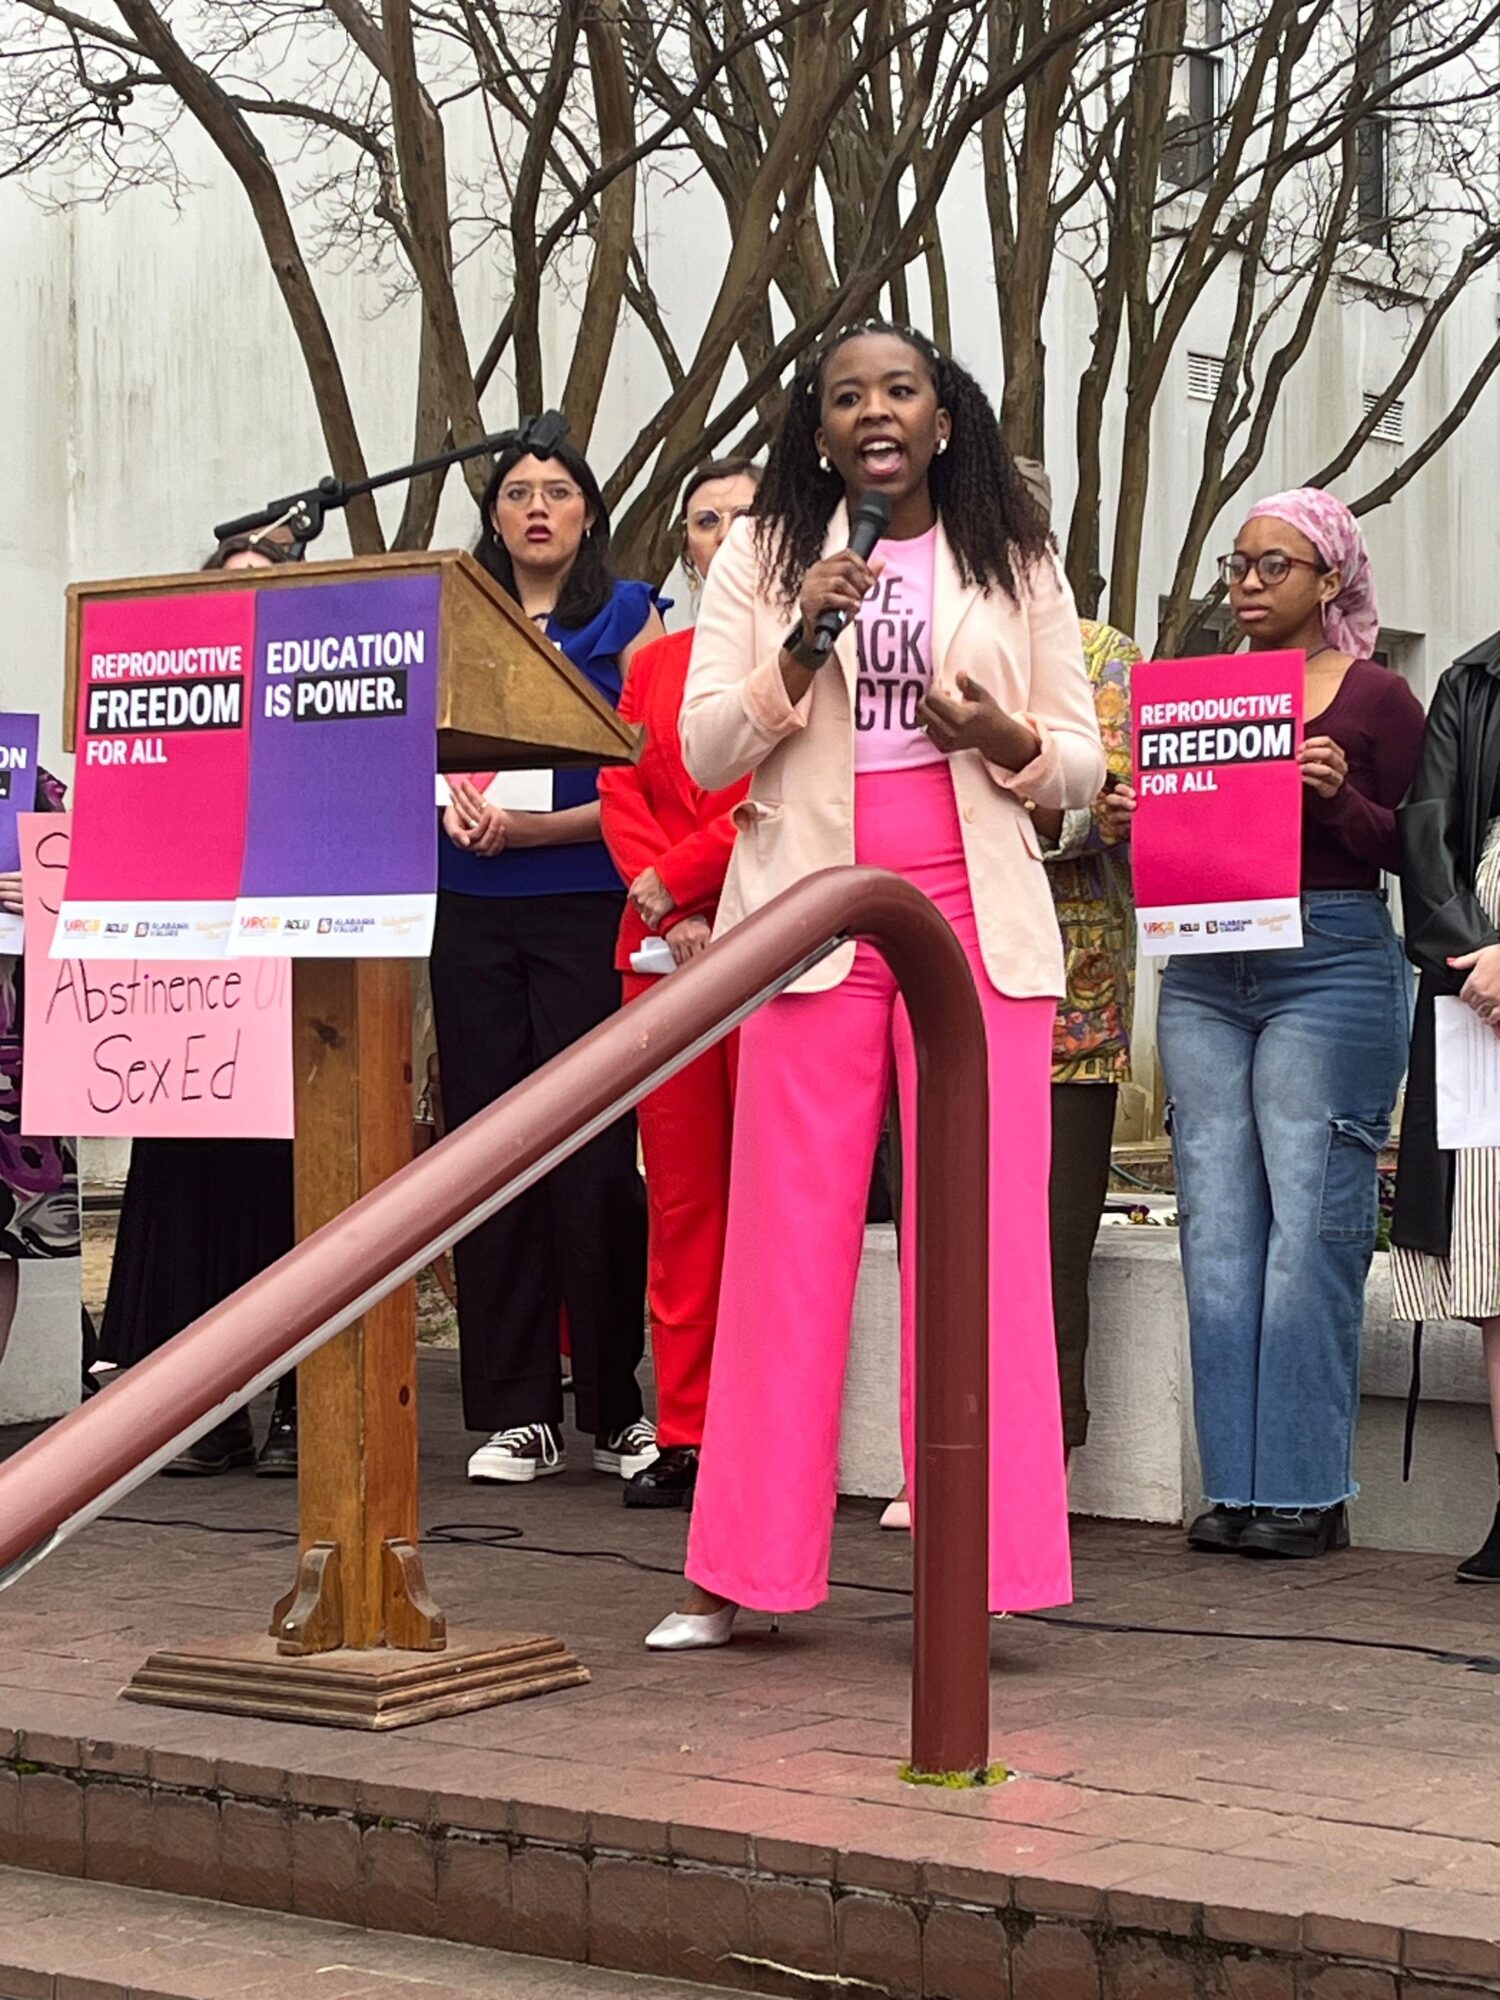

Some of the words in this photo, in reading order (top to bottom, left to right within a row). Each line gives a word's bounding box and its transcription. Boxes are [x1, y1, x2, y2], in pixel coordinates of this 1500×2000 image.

[91, 645, 242, 679] REPRODUCTIVE
[266, 630, 424, 674] EDUCATION
[89, 683, 240, 729] FREEDOM
[264, 683, 291, 717] IS
[297, 676, 403, 716] POWER.
[1141, 693, 1292, 726] REPRODUCTIVE
[86, 740, 127, 766] FOR
[130, 738, 168, 764] ALL
[1141, 723, 1292, 767] FREEDOM
[1141, 773, 1178, 797] FOR
[1182, 769, 1218, 793] ALL
[46, 958, 241, 1023] Abstinence
[88, 1034, 171, 1113] Sex
[182, 1028, 241, 1101] Ed
